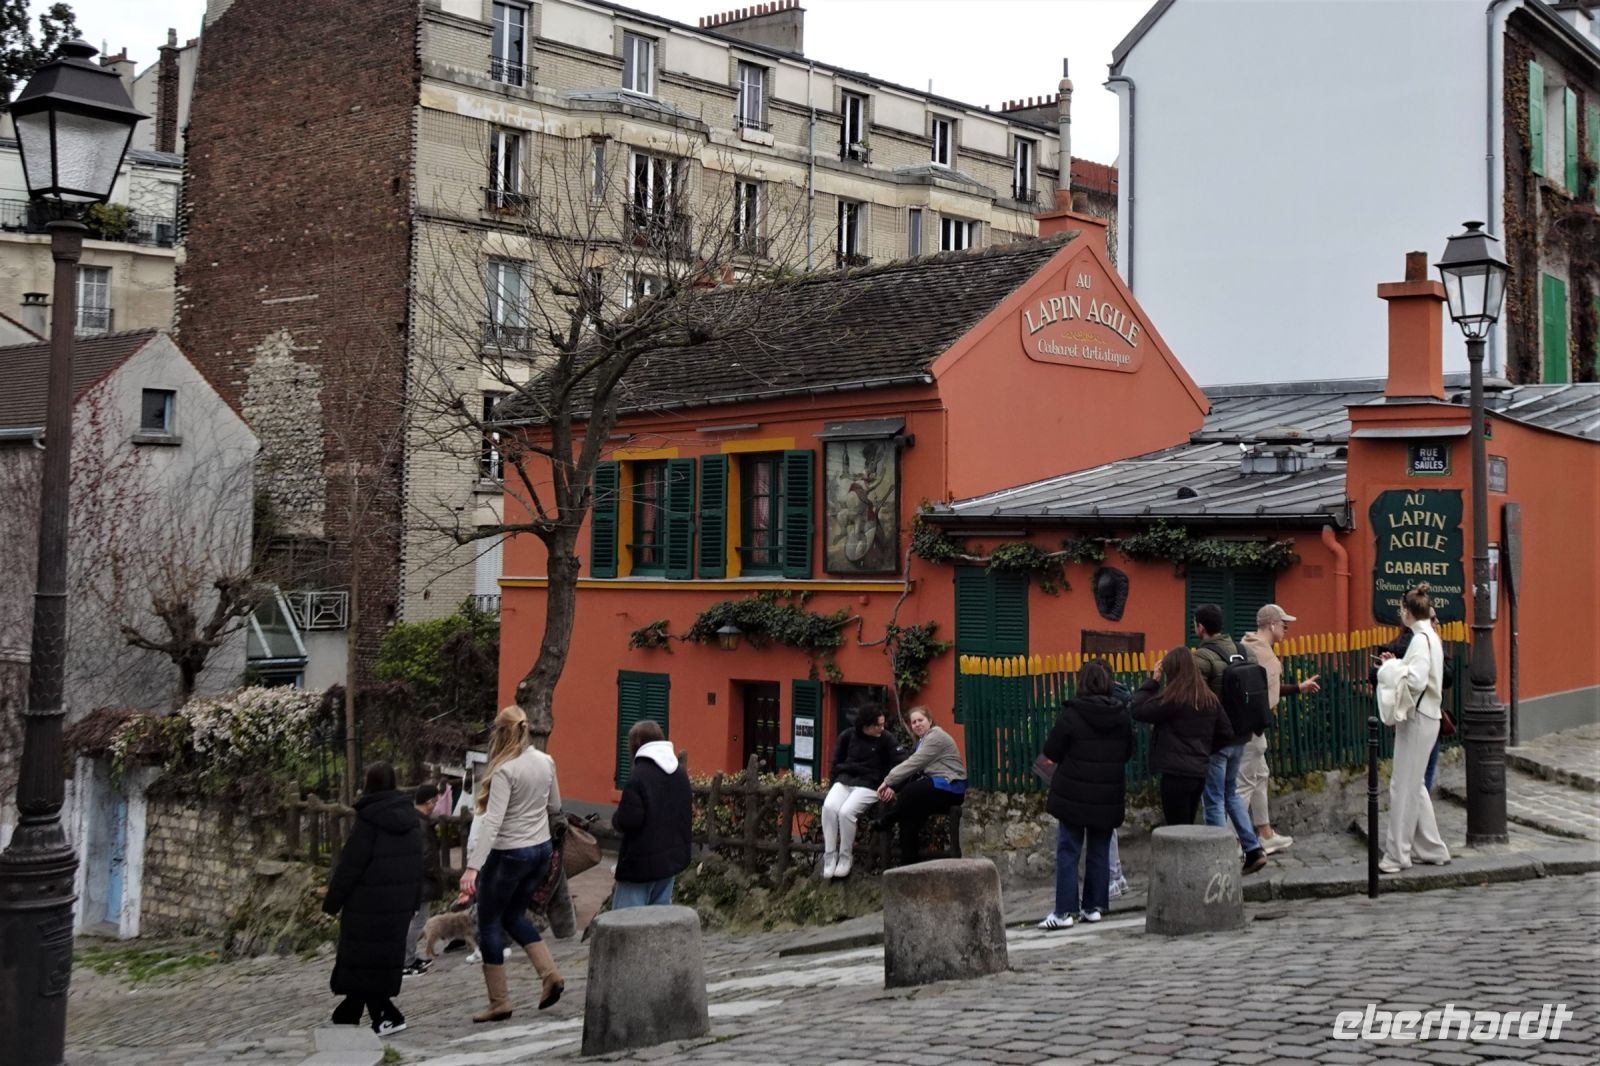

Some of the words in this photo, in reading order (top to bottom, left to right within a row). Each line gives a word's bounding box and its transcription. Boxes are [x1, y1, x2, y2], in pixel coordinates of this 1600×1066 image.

[1076, 273, 1091, 289] AU
[1024, 295, 1081, 335] LAPIN
[1085, 297, 1140, 348] AGILE
[1038, 338, 1079, 357] Cabaret
[1082, 344, 1131, 366] Artistique
[1420, 448, 1438, 457] RUE
[1414, 460, 1444, 470] SAULES
[1404, 494, 1425, 506] AU
[1388, 511, 1447, 530] LAPIN
[1389, 531, 1448, 553] AGILE
[1385, 561, 1449, 576] CABARET
